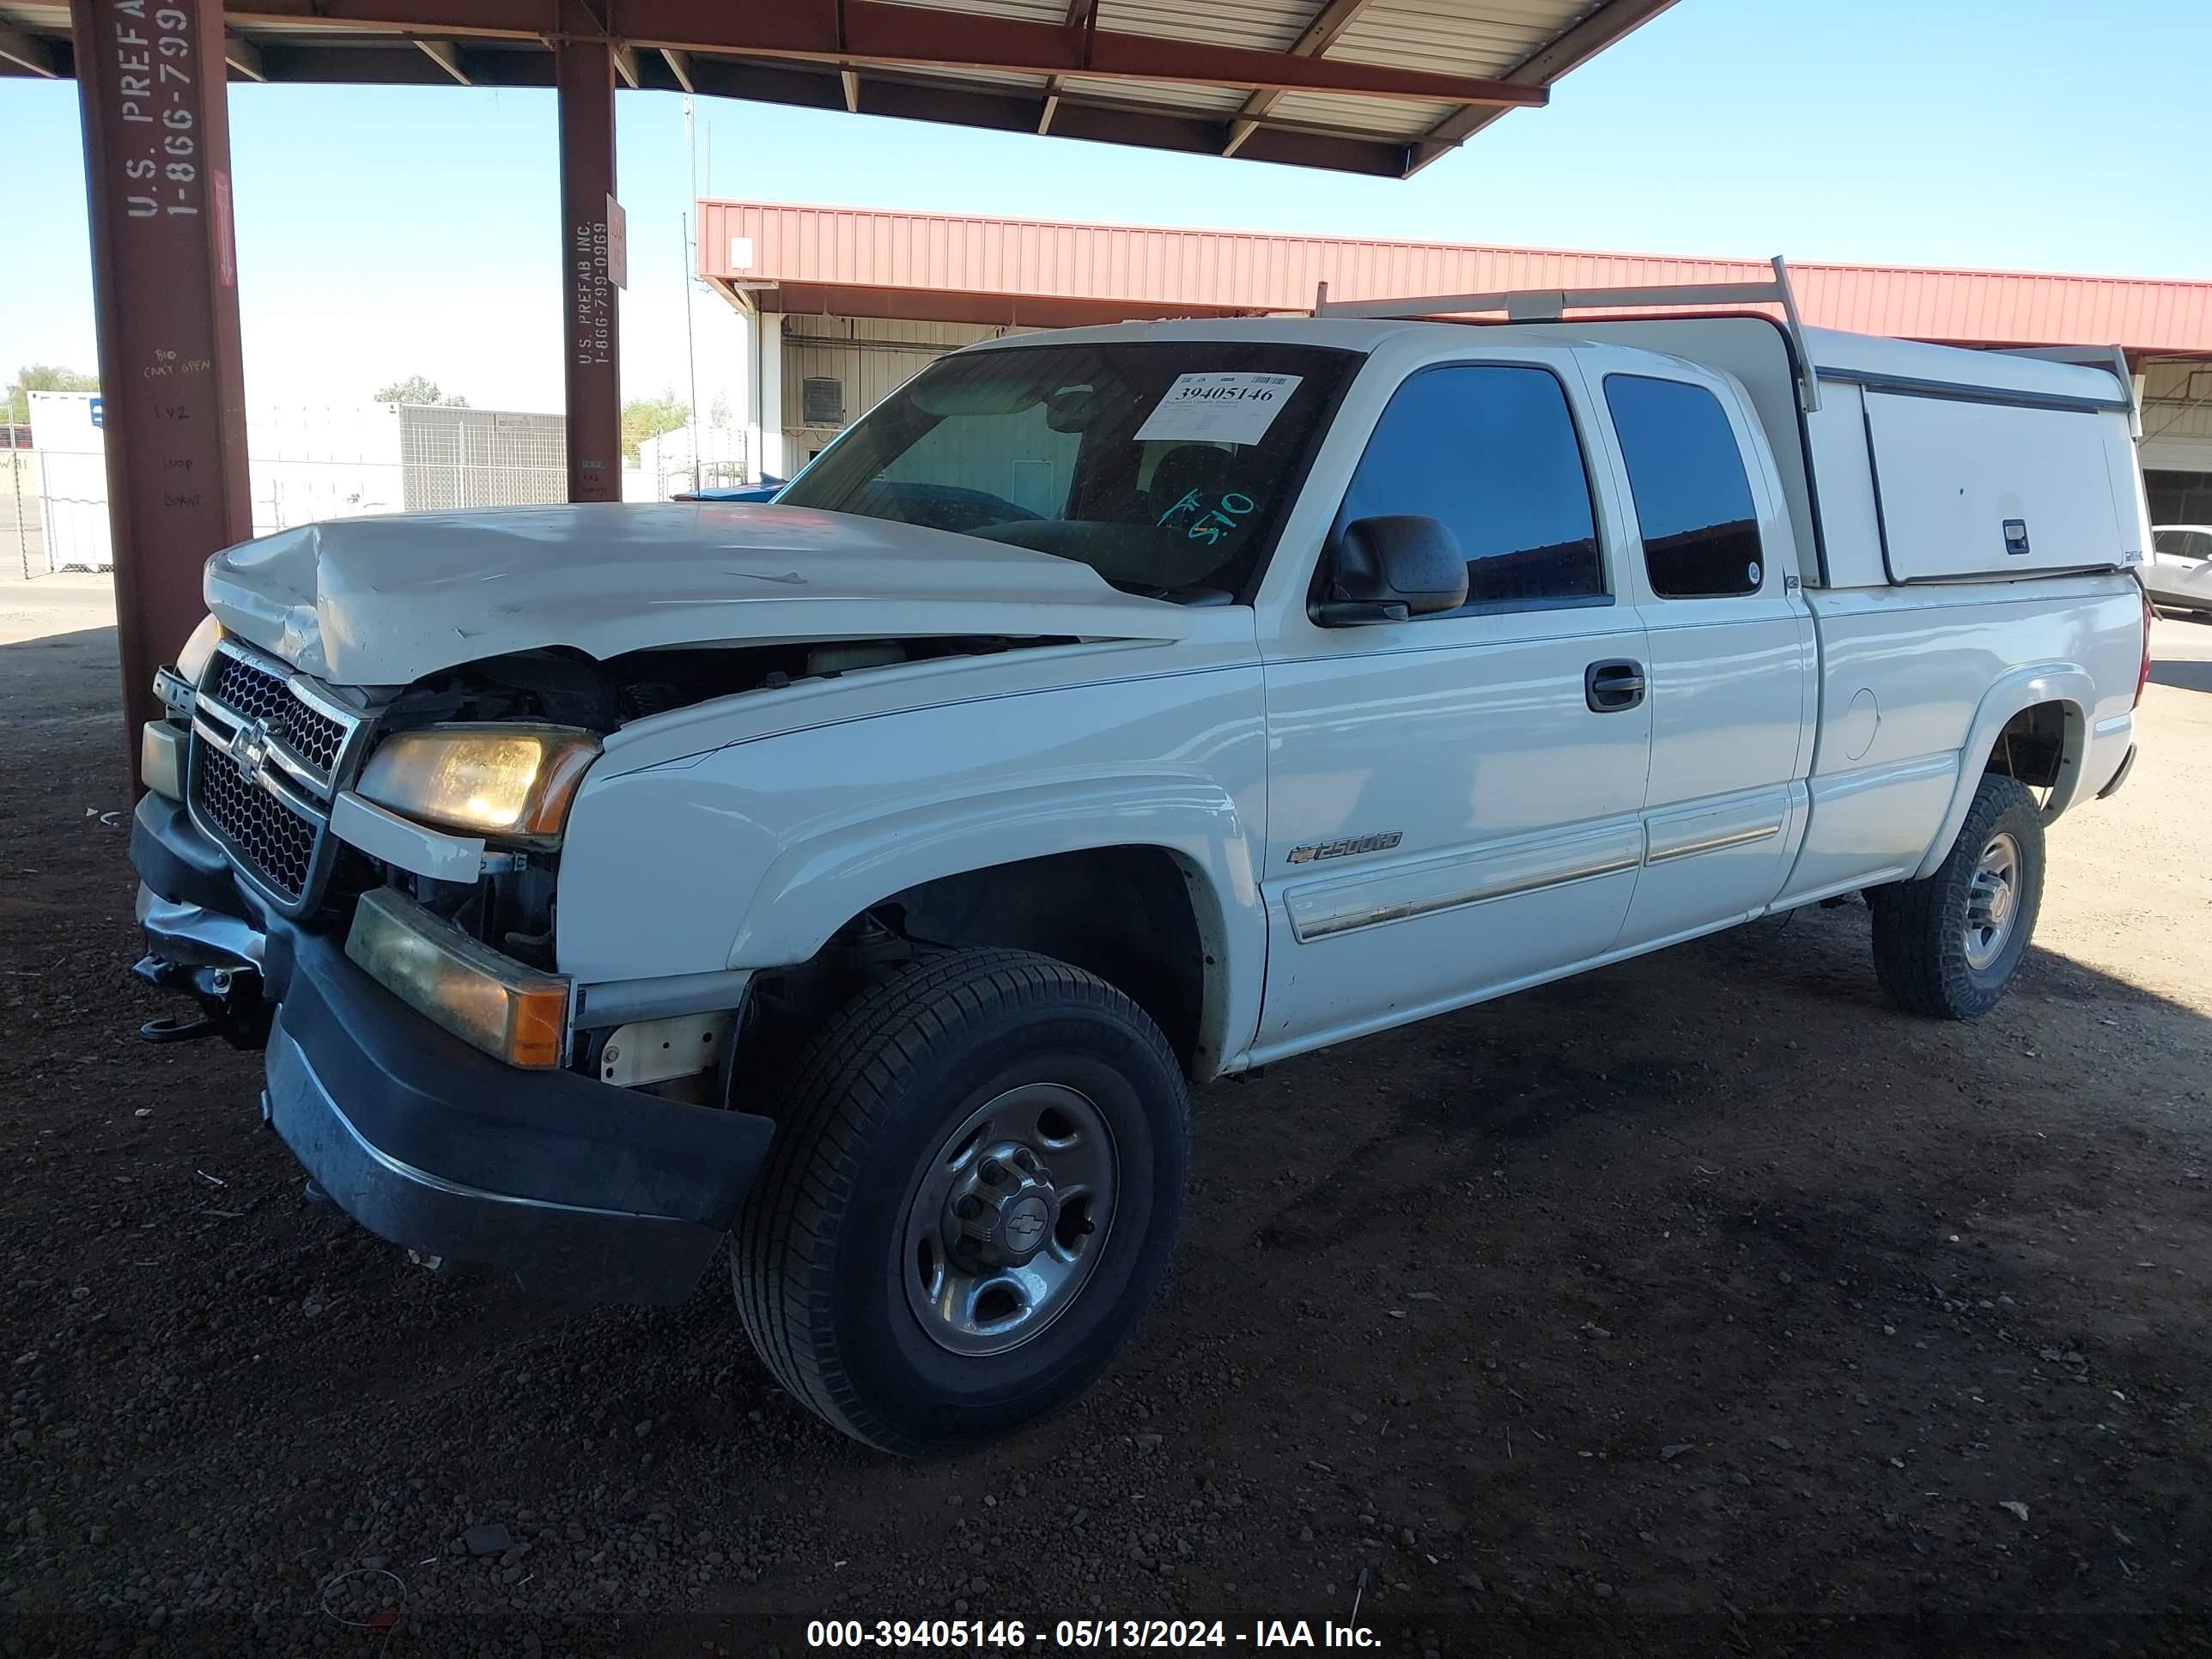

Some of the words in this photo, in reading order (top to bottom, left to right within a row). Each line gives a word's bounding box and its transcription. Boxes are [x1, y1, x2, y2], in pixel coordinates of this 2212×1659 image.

[155, 0, 198, 216] 1-866-799
[127, 148, 158, 216] U.S.
[576, 221, 591, 252] INC.
[577, 261, 592, 324] PREFAB
[593, 222, 610, 363] 1-866-799-0969
[578, 334, 592, 364] U.S.
[1176, 386, 1275, 402] 39405146
